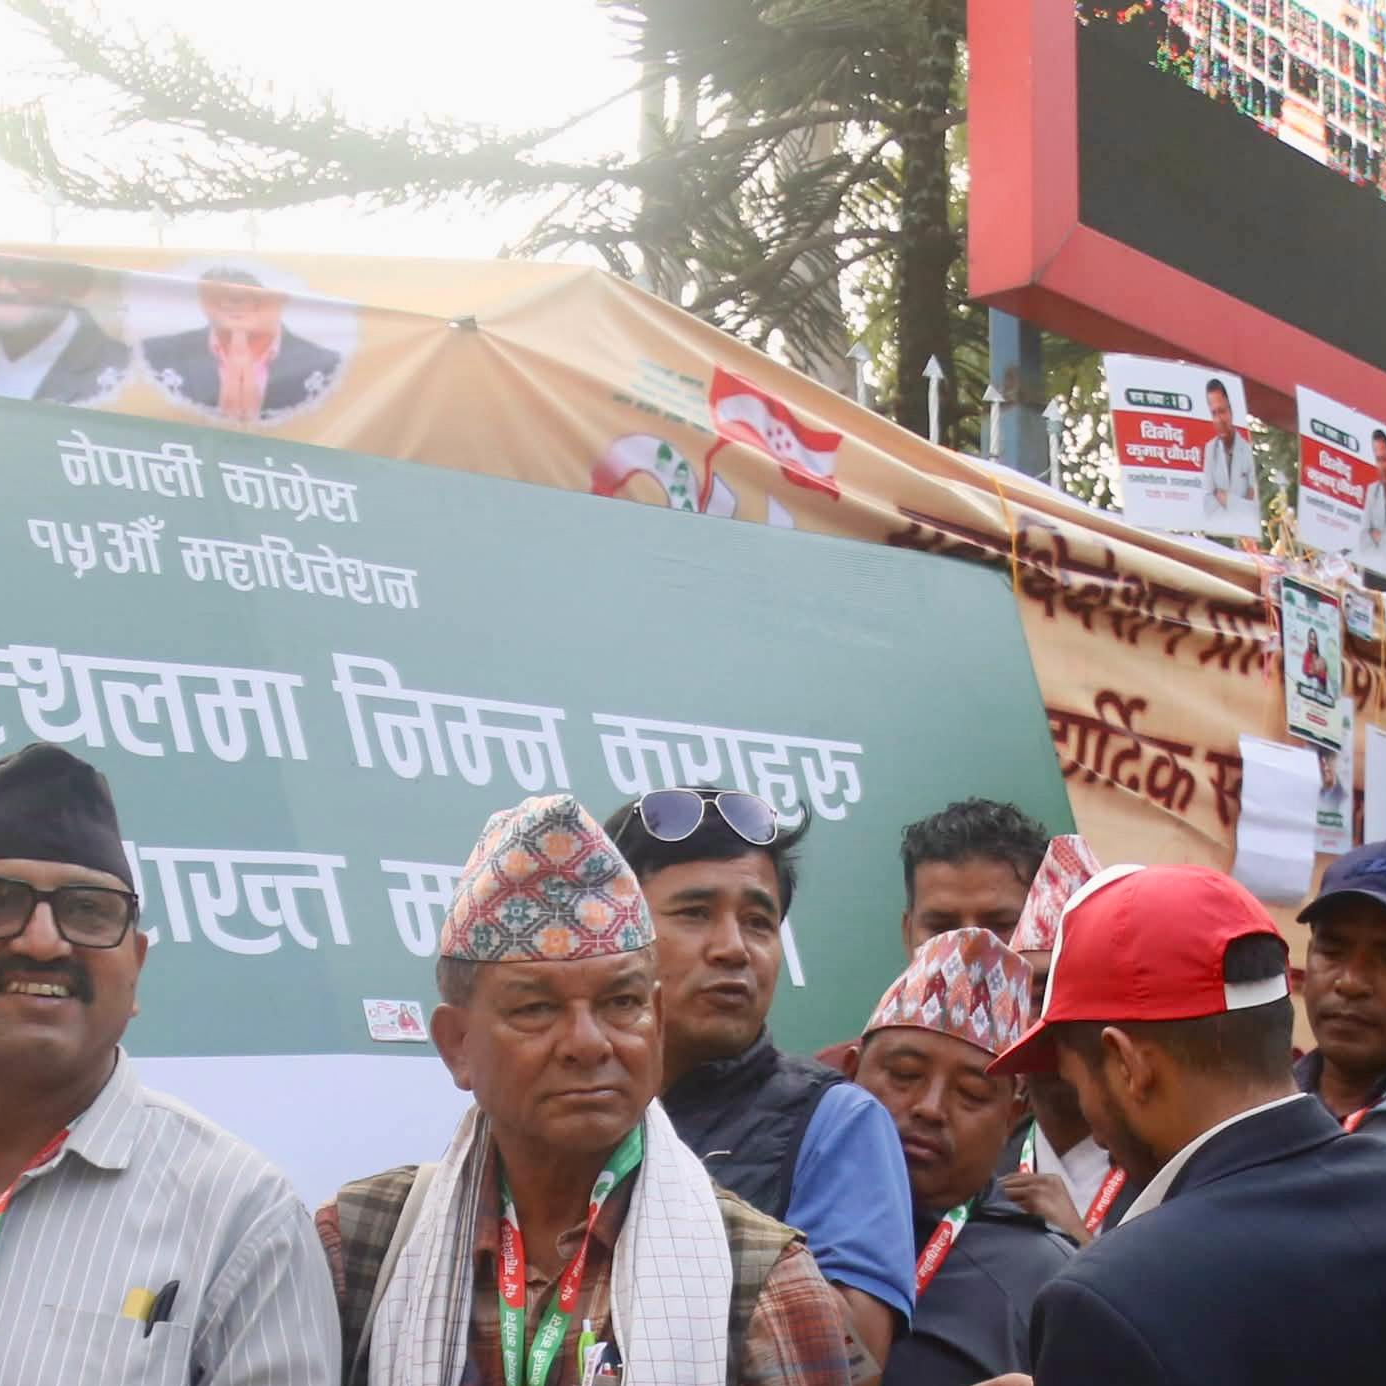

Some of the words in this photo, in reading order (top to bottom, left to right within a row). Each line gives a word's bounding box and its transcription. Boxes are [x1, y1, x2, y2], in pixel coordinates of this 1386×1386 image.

[56, 429, 205, 499] नेपाली
[218, 457, 359, 523] कांग्रेस
[177, 534, 420, 610] महाधिवेशन
[332, 652, 573, 794] निम्न
